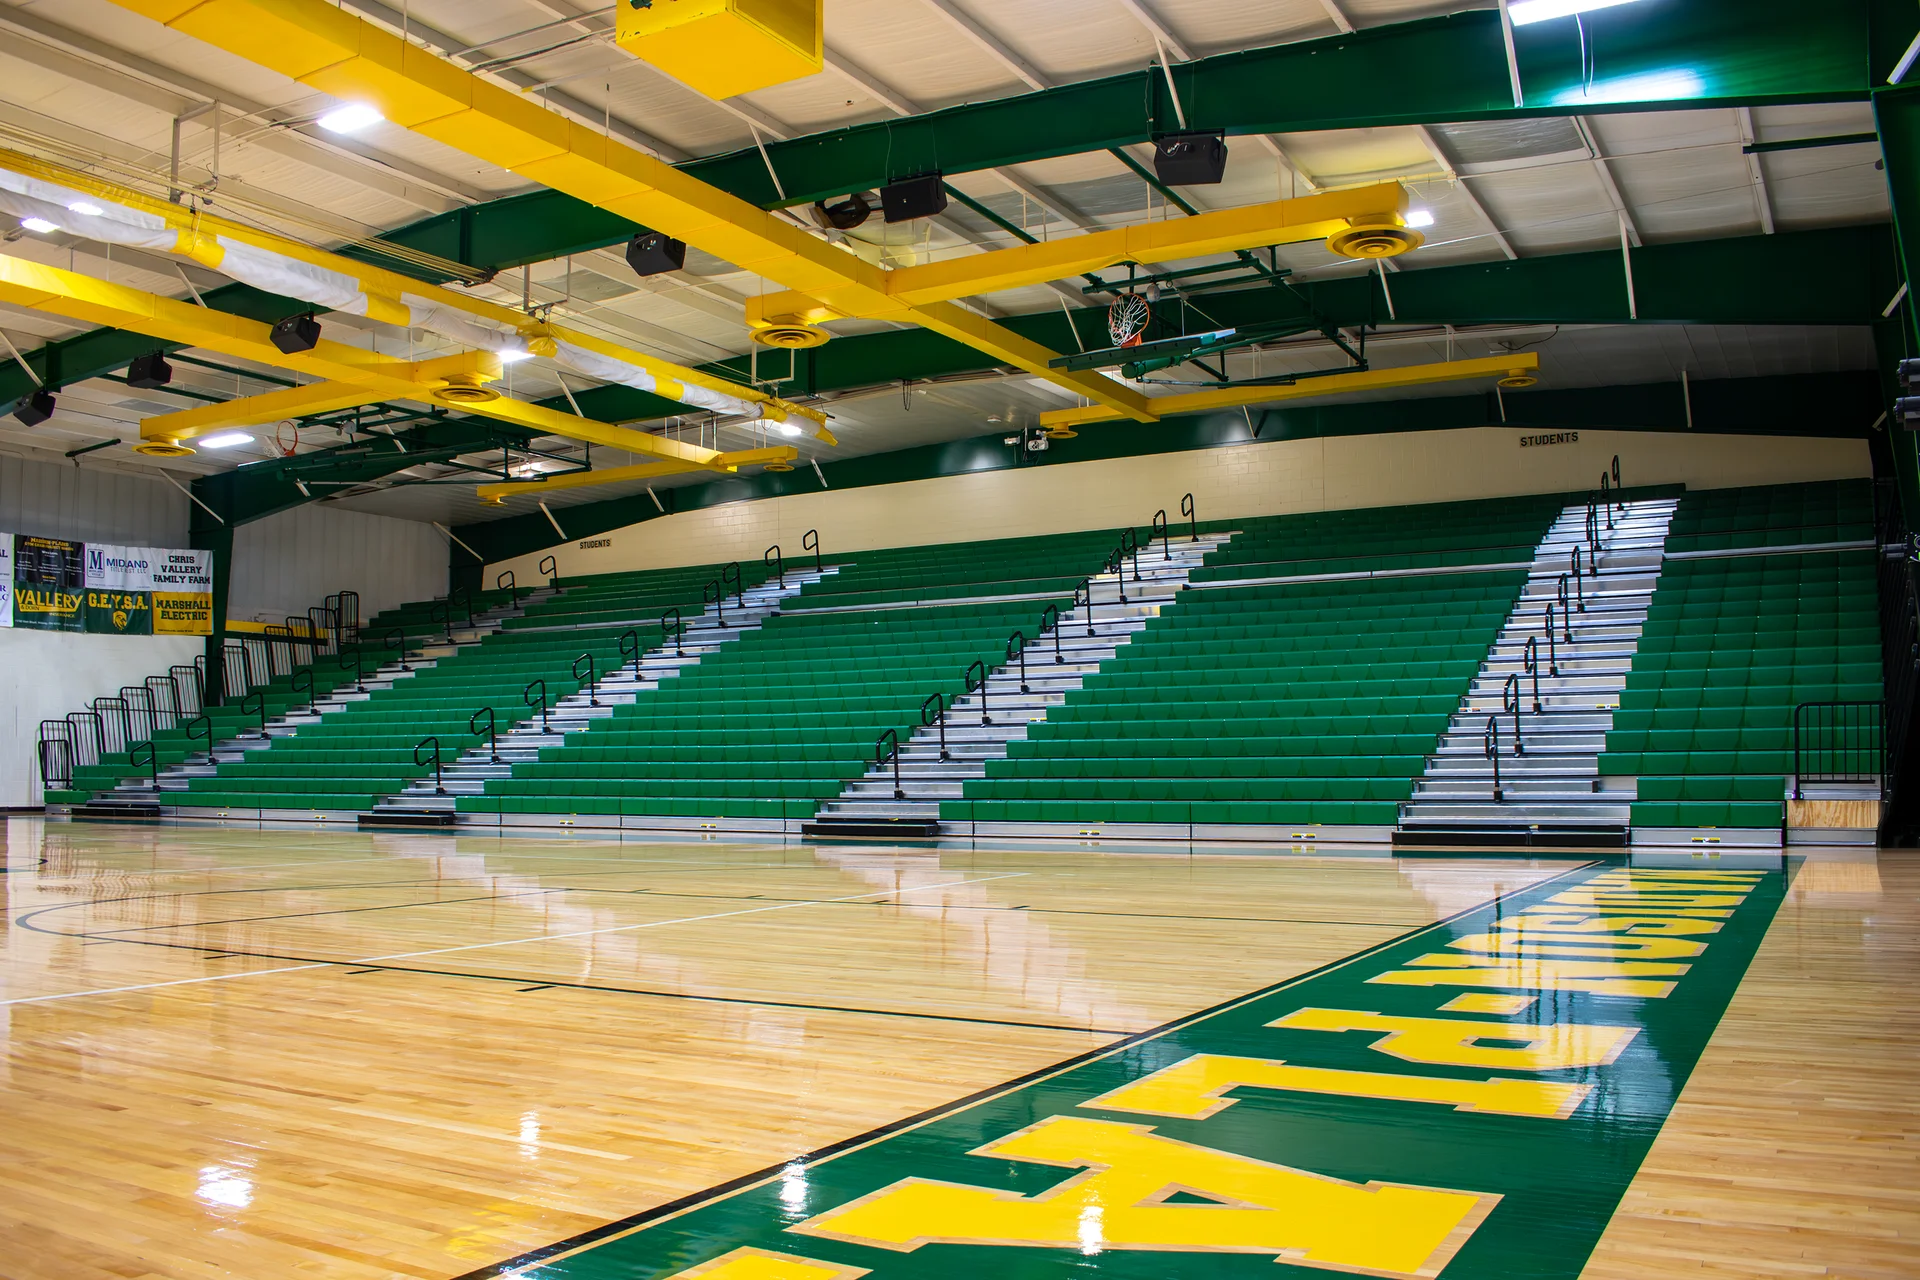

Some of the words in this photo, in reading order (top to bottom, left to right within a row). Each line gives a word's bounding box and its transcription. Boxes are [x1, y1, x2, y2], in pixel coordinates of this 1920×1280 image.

[1520, 432, 1579, 447] STUDENTS
[580, 539, 611, 549] STUDENTS
[168, 555, 195, 564] CHRIS
[161, 565, 203, 574] VALLERY
[153, 574, 187, 584] FAMILY
[189, 575, 211, 585] FARM
[15, 588, 83, 609] VALLERY
[88, 593, 149, 610] G.E.Y.S.A.
[156, 599, 211, 610] MARSHALL
[161, 610, 208, 620] ELECTRIC
[664, 868, 1769, 1280] MADISON-PLA
